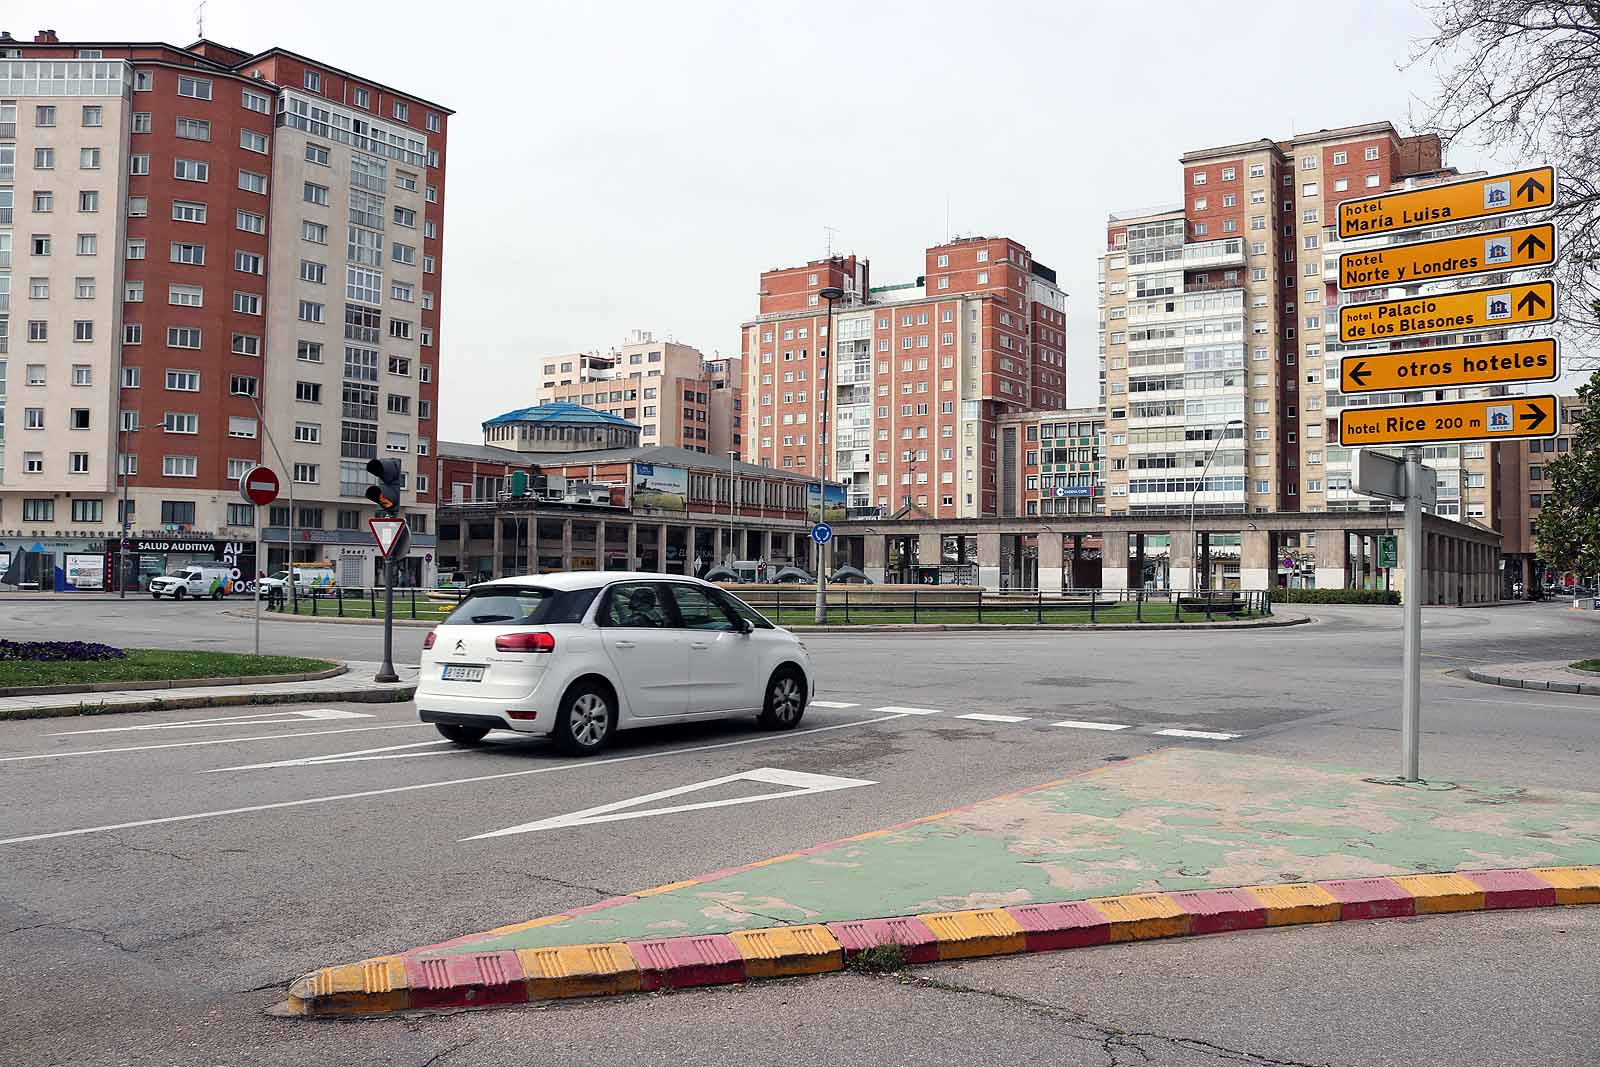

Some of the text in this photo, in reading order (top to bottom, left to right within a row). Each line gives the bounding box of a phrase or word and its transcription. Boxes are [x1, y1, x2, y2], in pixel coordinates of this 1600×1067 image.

[1346, 200, 1382, 216] hotel
[1346, 206, 1450, 233] María Luisa
[1346, 253, 1384, 268] hotel
[1346, 256, 1478, 284] Norte y Londres
[1347, 301, 1436, 322] hotel Palacio
[1347, 313, 1474, 337] de los Blasones
[1397, 352, 1547, 378] otros hoteles
[1347, 417, 1480, 435] hotel Rice 200 m
[138, 542, 215, 552] SALUD AUDITIVA
[223, 542, 243, 555] AU
